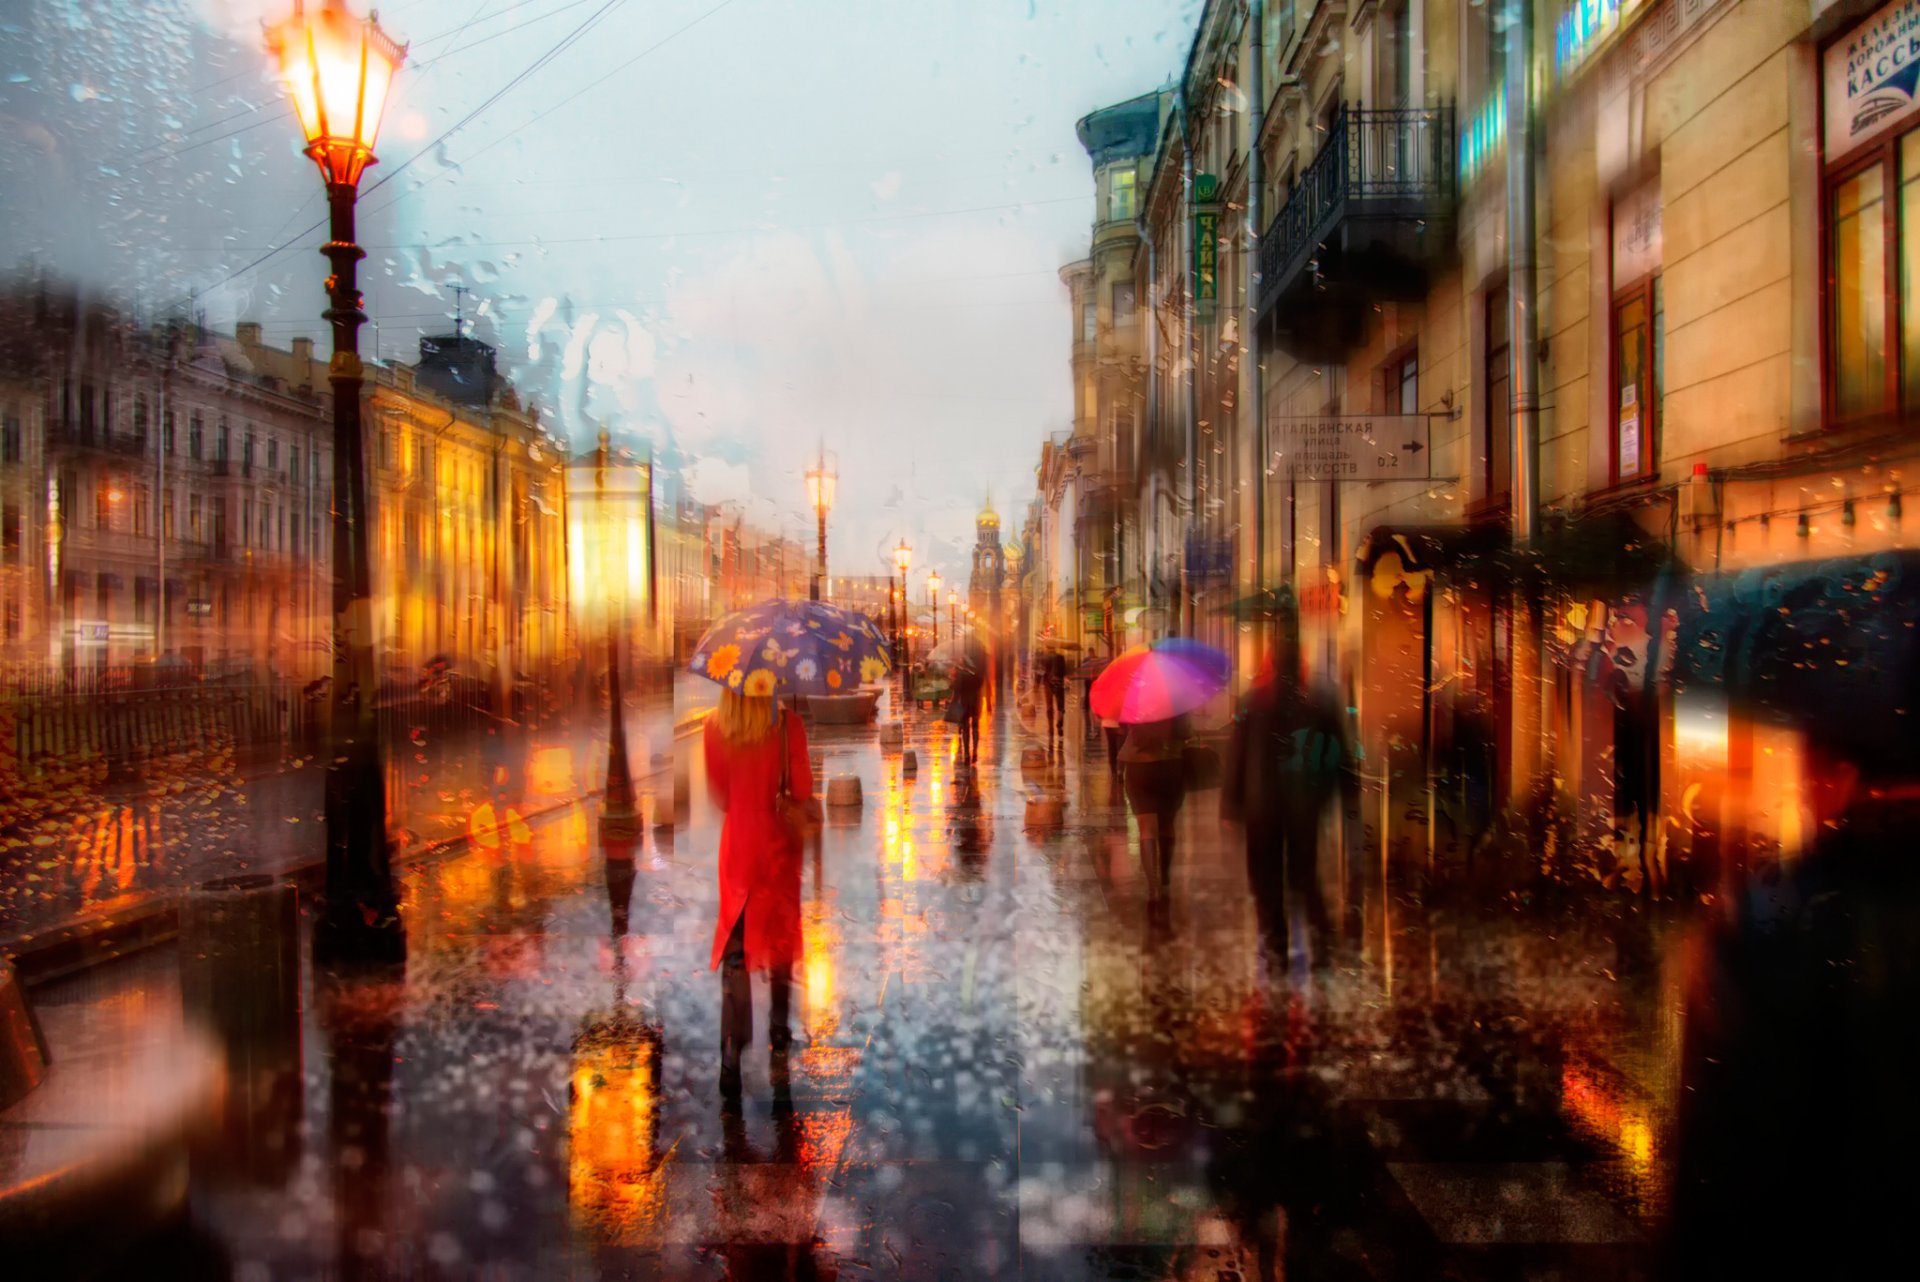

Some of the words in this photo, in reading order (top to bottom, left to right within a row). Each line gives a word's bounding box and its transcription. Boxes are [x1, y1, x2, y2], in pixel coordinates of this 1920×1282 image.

[1848, 0, 1920, 56] ЖЕЛЕЗН
[1200, 216, 1214, 298] ЧАЙКА
[1272, 422, 1373, 434] ИТАЛЬЯНСКАЯ
[1303, 437, 1340, 447] улица
[1294, 451, 1350, 461] площадь
[1286, 463, 1358, 474] ИСКУССТВ
